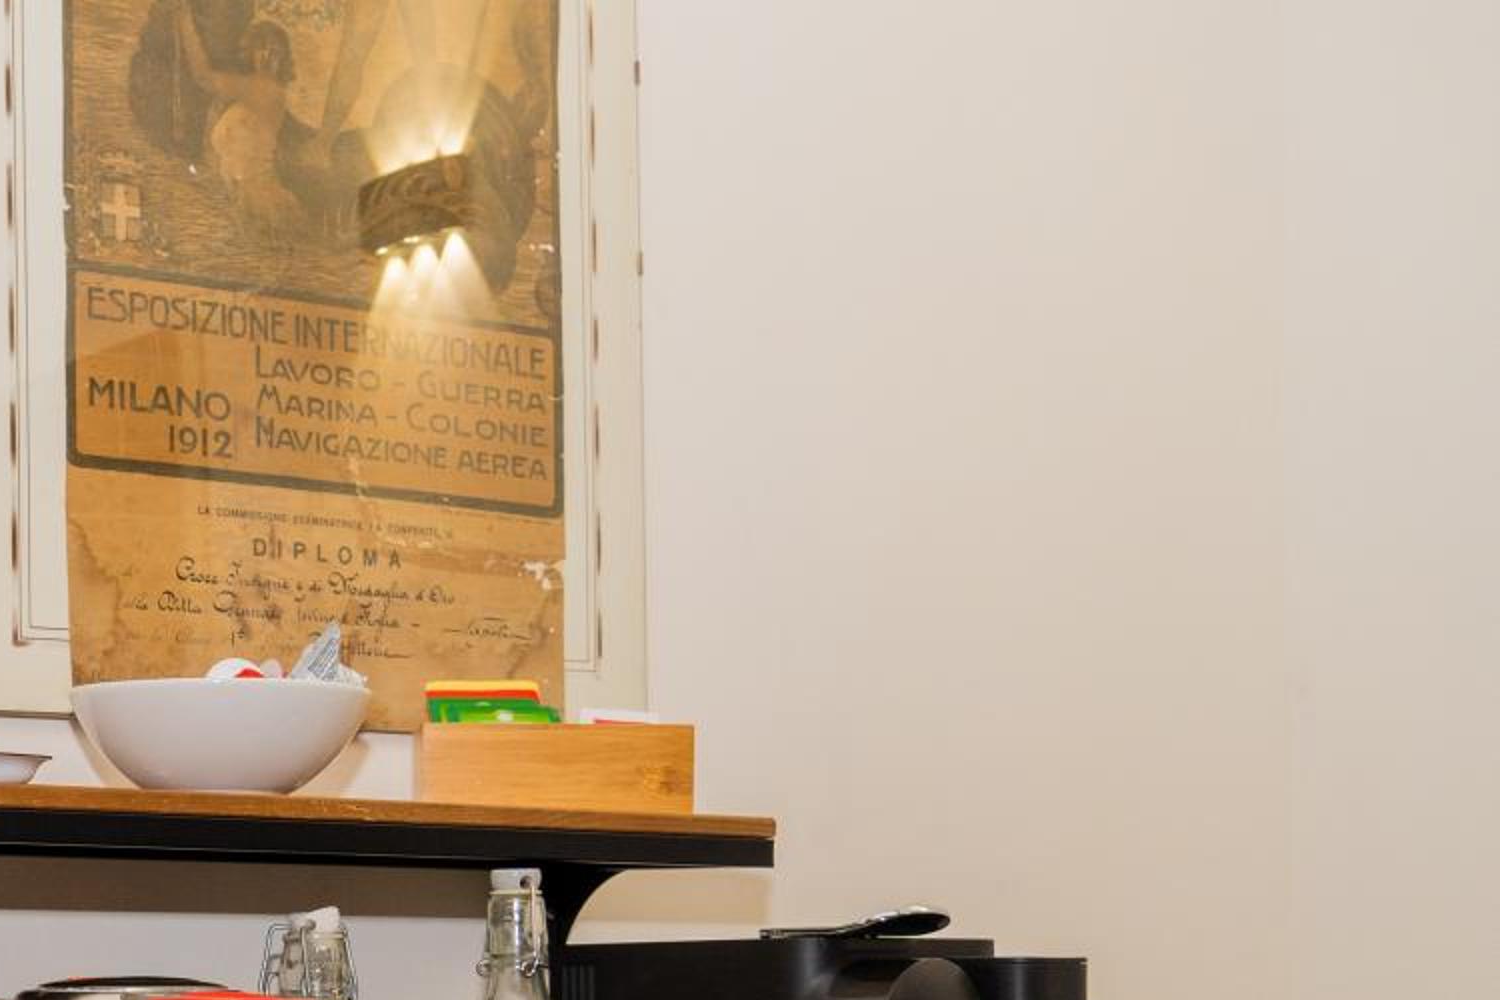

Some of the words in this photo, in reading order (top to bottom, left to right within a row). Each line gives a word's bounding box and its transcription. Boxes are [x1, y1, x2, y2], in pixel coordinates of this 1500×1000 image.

[86, 286, 285, 343] ESPOSIZIONE
[294, 315, 548, 382] INTERNAZIONALE
[88, 377, 232, 422] MILANO
[255, 345, 381, 391] LAVORO
[416, 371, 546, 413] GUERRA
[167, 425, 233, 459] 1912
[255, 415, 448, 469] NAVIGAZIONE
[457, 450, 548, 481] AEREA
[256, 386, 379, 425] MARINA
[406, 402, 548, 448] COLONIE
